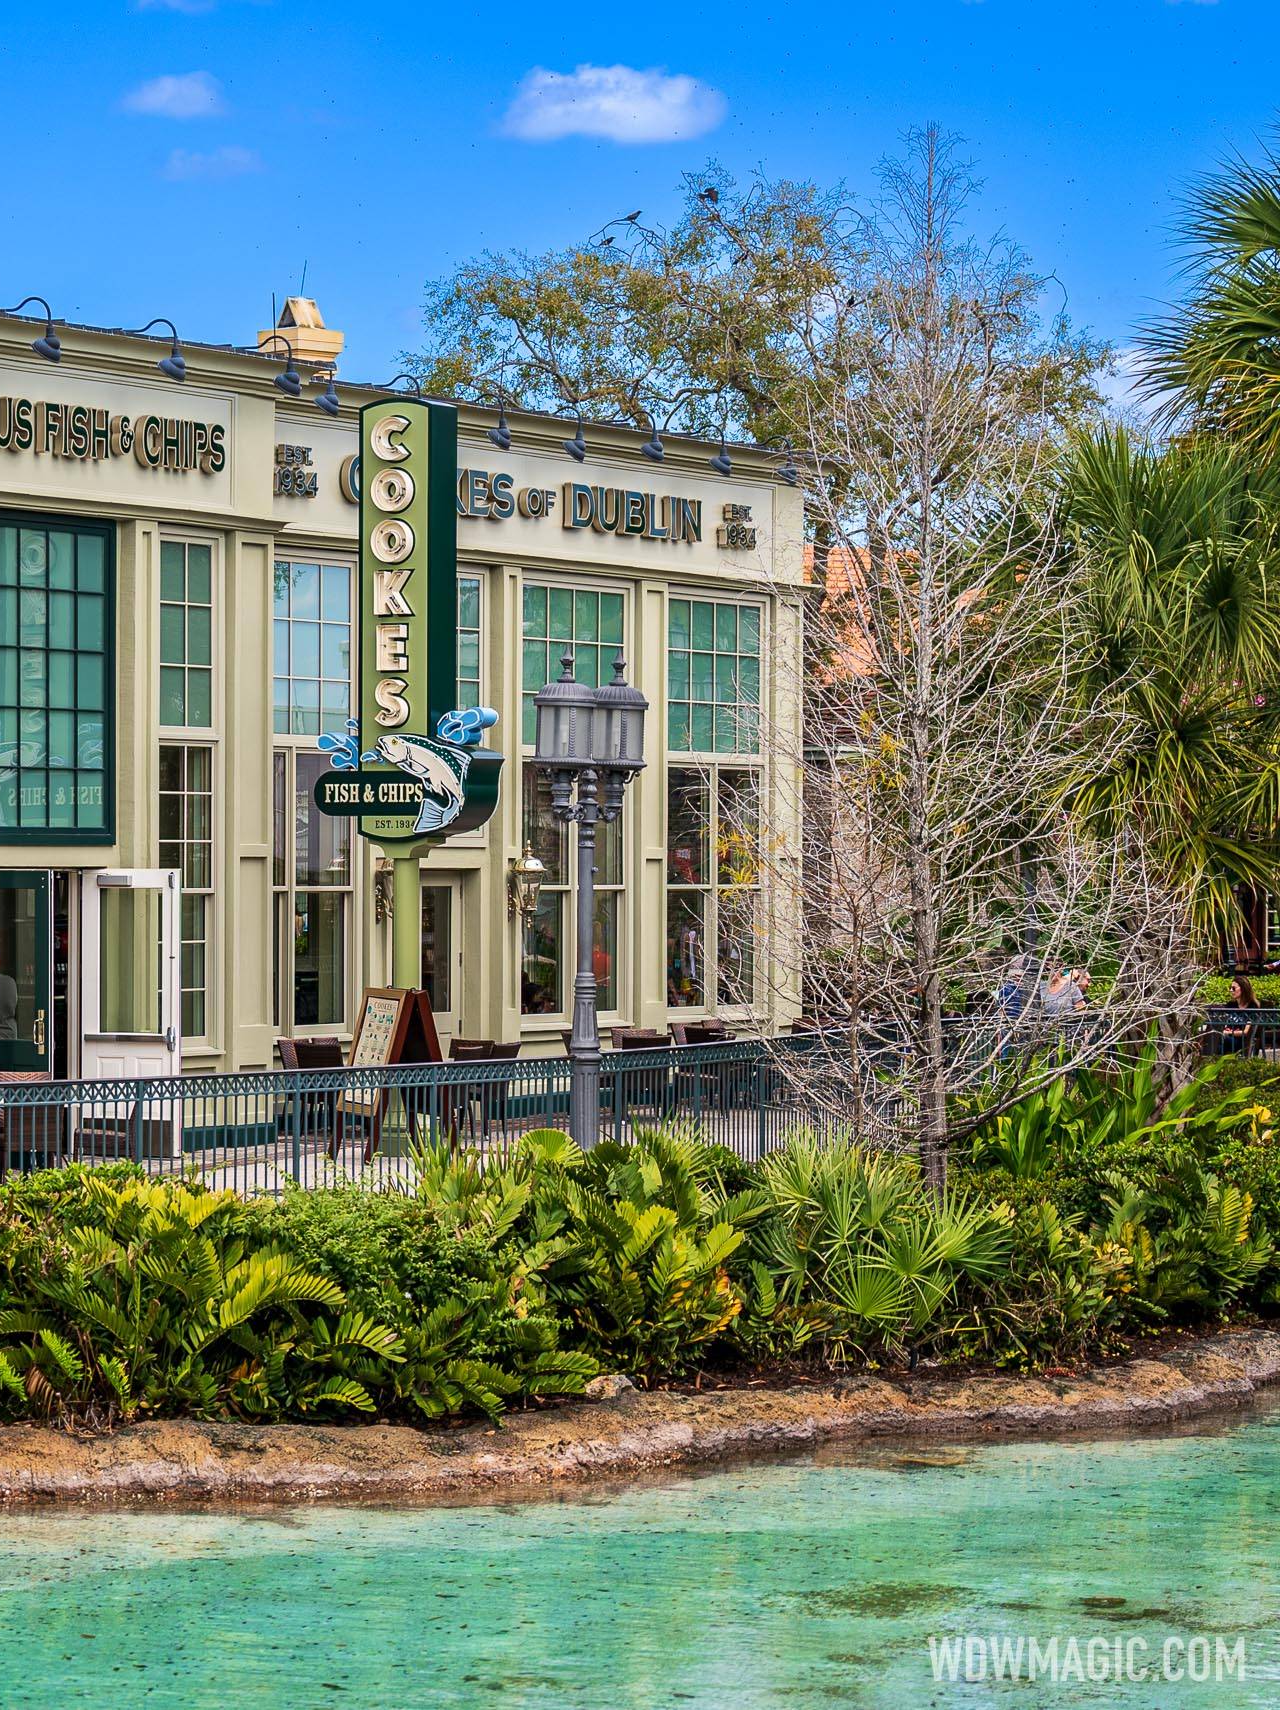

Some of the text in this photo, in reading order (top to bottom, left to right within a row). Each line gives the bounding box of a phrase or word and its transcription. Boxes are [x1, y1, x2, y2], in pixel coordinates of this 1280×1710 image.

[39, 400, 110, 461] FISH
[114, 414, 134, 455] &
[137, 415, 226, 473] CHIPS
[280, 444, 313, 466] EST.
[274, 467, 319, 497] 1934
[522, 487, 557, 518] OF
[567, 482, 703, 543] DUBLIN
[726, 503, 753, 522] EST.
[718, 523, 757, 550] 1934
[370, 414, 415, 728] COOKES
[324, 782, 424, 803] FISH & CHIPS
[375, 819, 415, 829] EST. 1934
